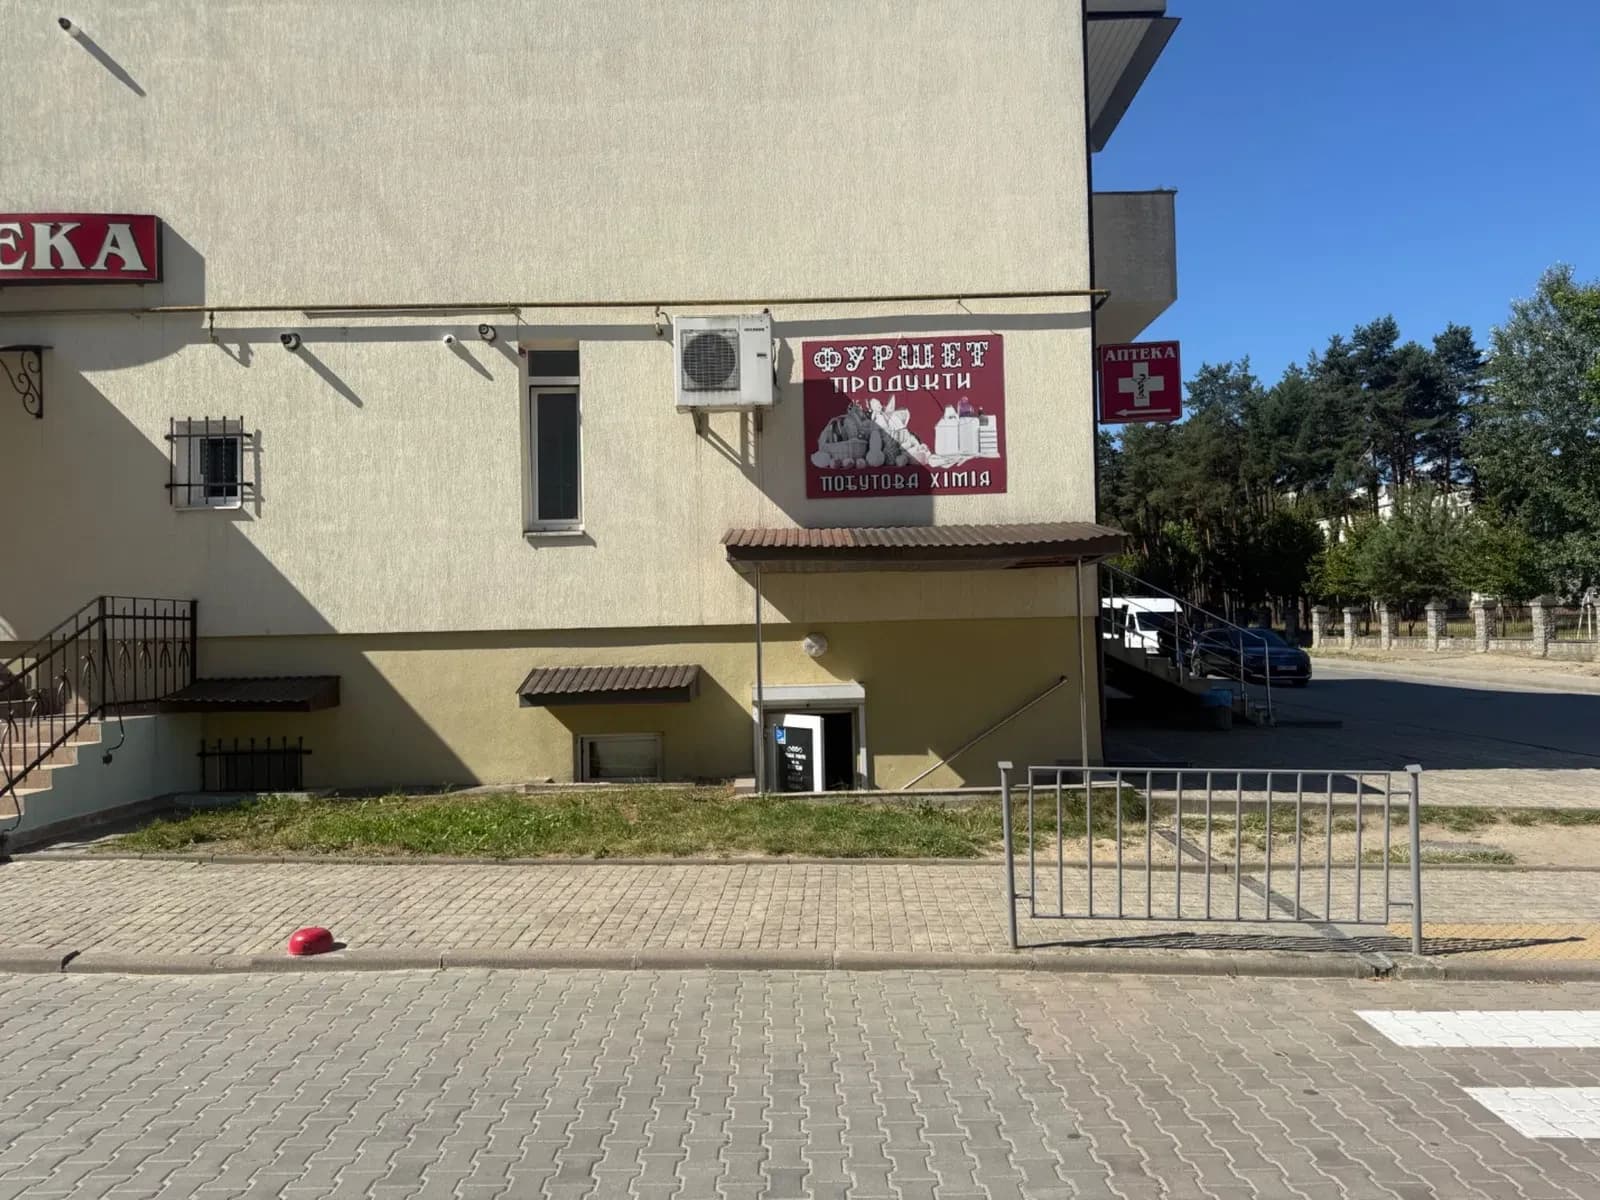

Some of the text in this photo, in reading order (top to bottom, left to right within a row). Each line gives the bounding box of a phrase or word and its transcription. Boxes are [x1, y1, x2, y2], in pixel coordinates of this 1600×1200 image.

[813, 341, 989, 373] ФУРШЕТ
[1105, 346, 1177, 361] АПТЕКА
[830, 372, 971, 393] ПРОДУКТИ
[819, 470, 991, 492] ПОБУТОВА ХІМІЯ
